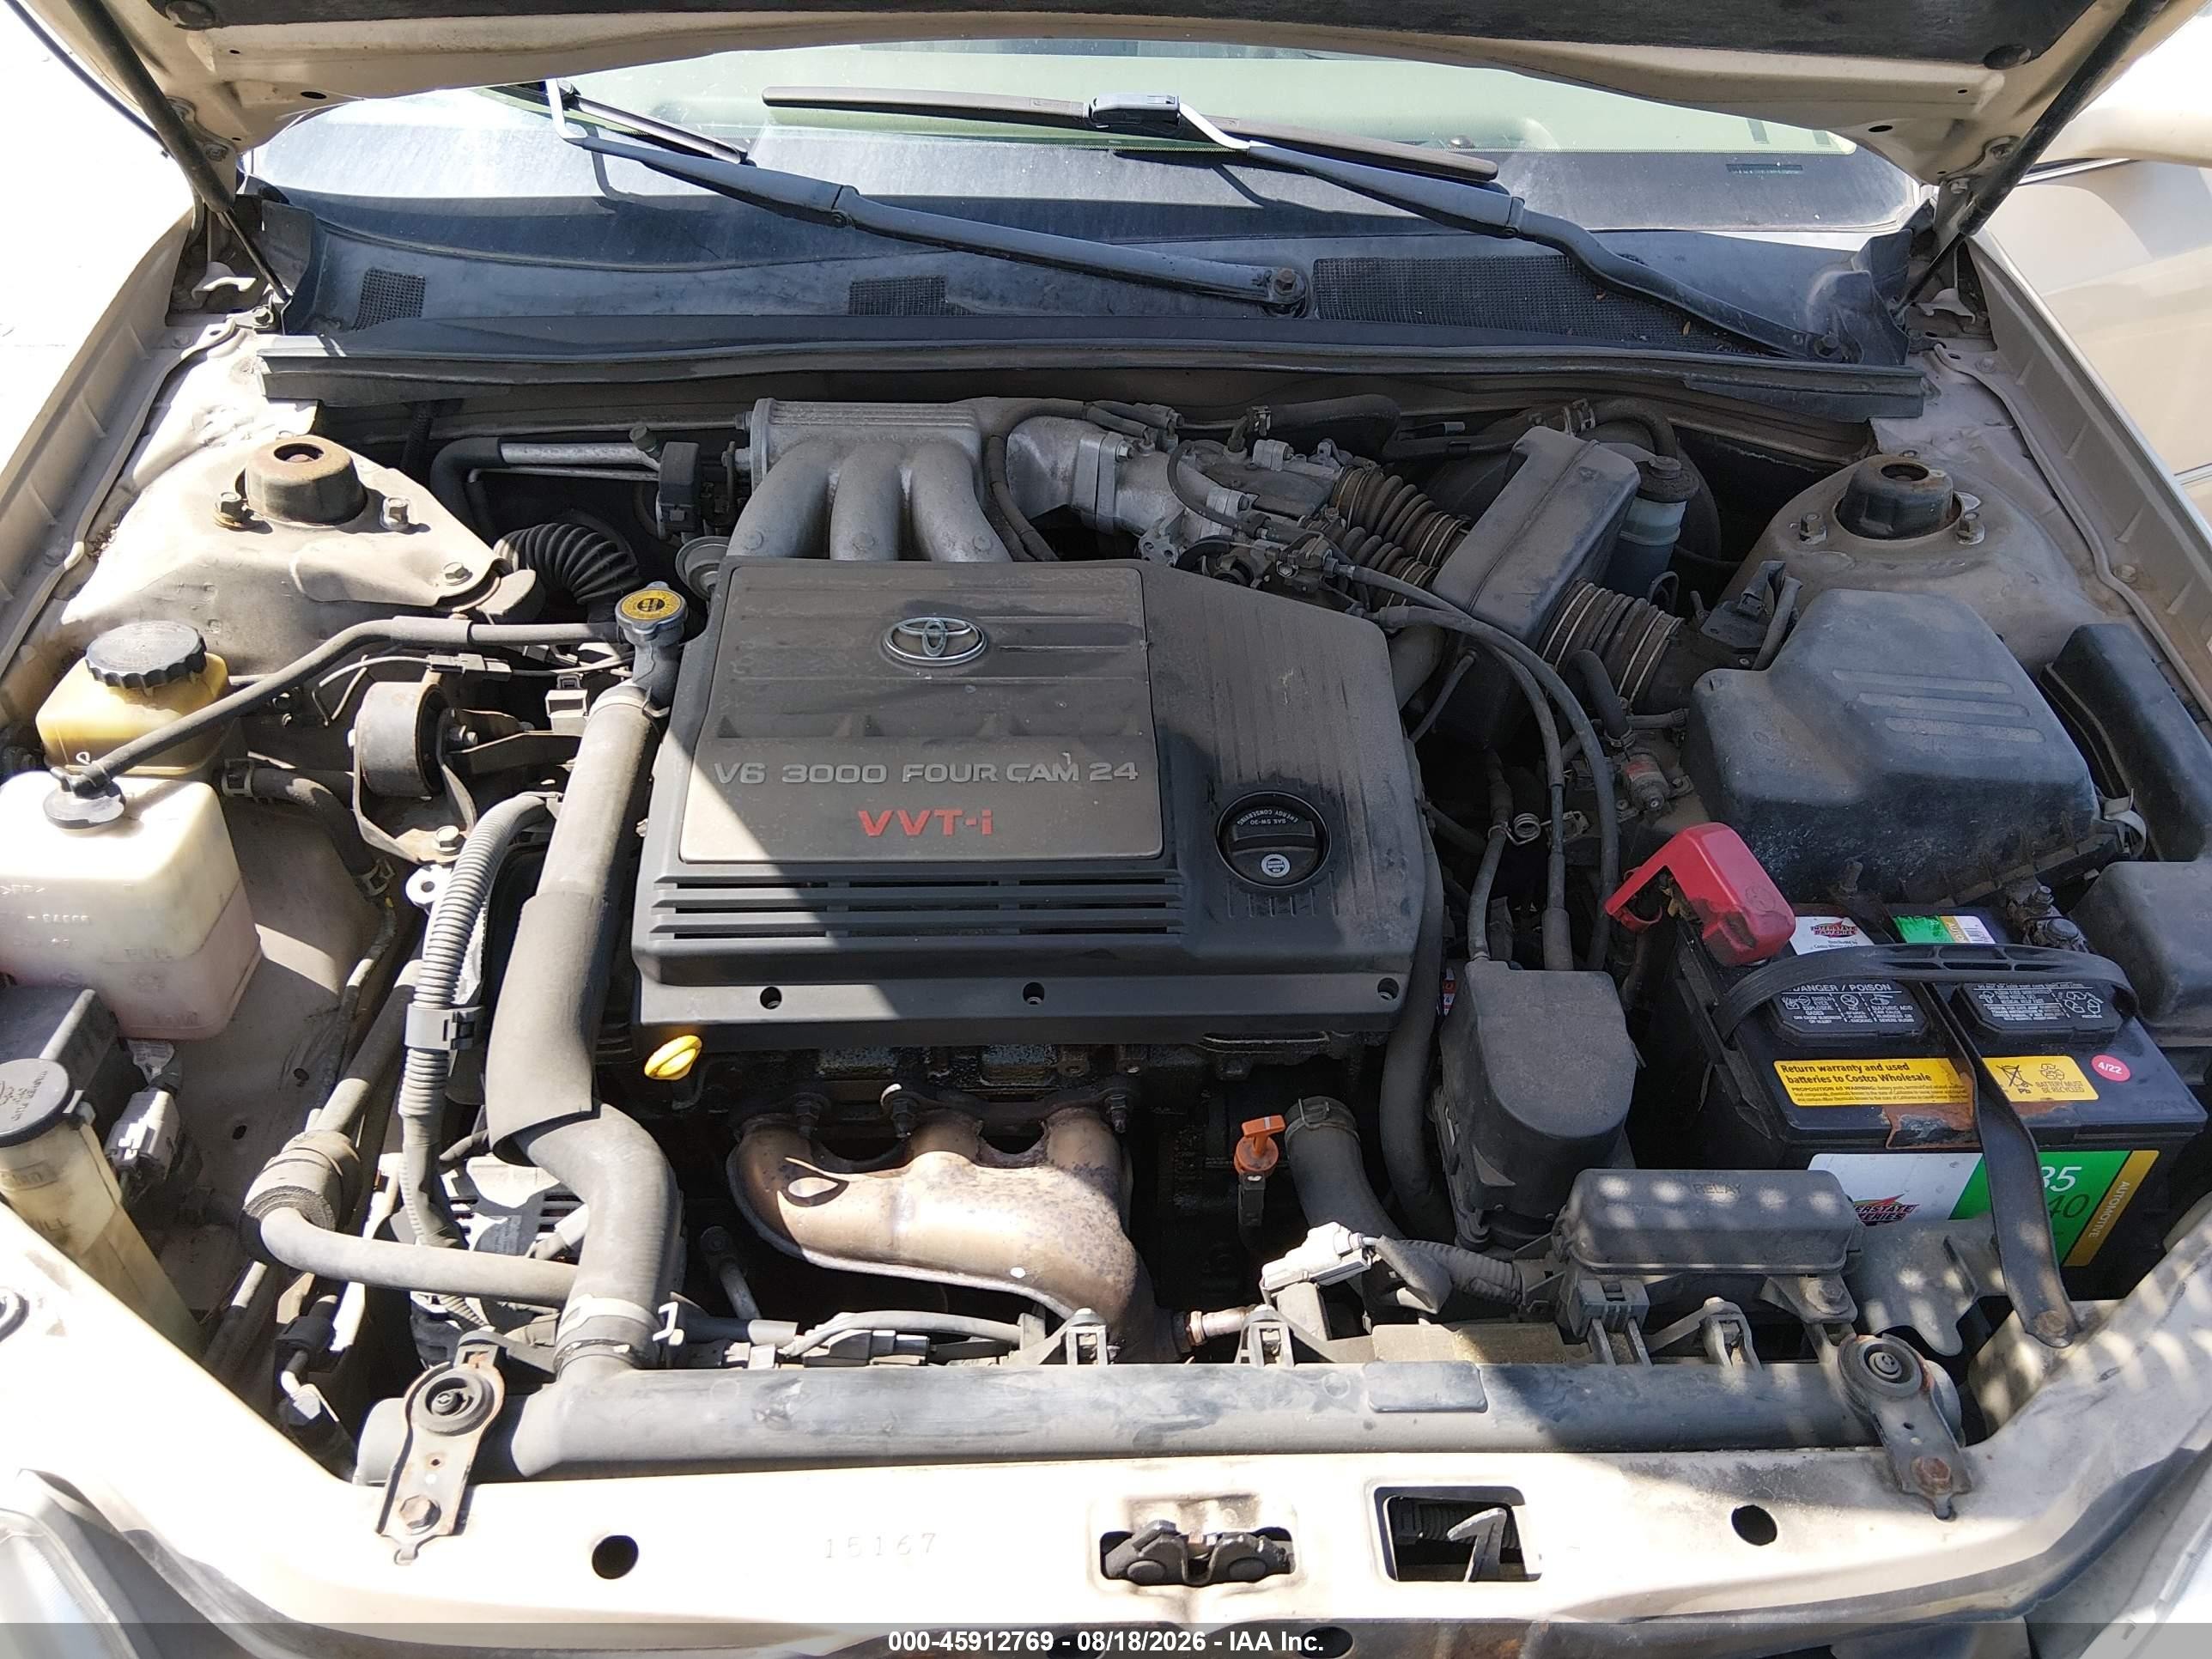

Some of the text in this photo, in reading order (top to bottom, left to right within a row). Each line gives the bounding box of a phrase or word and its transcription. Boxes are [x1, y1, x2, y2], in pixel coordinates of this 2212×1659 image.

[714, 761, 1139, 783] V6 3000 FOUR CAM 24
[858, 809, 994, 836] VVT-i
[1816, 1065, 1863, 1073] warranty
[1864, 1063, 1884, 1072] and
[1886, 1062, 1910, 1071] used
[1880, 1073, 1932, 1082] Wholesale
[1692, 1182, 1743, 1194] RELAY
[2087, 1181, 2130, 1238] AUTOMOTIVE
